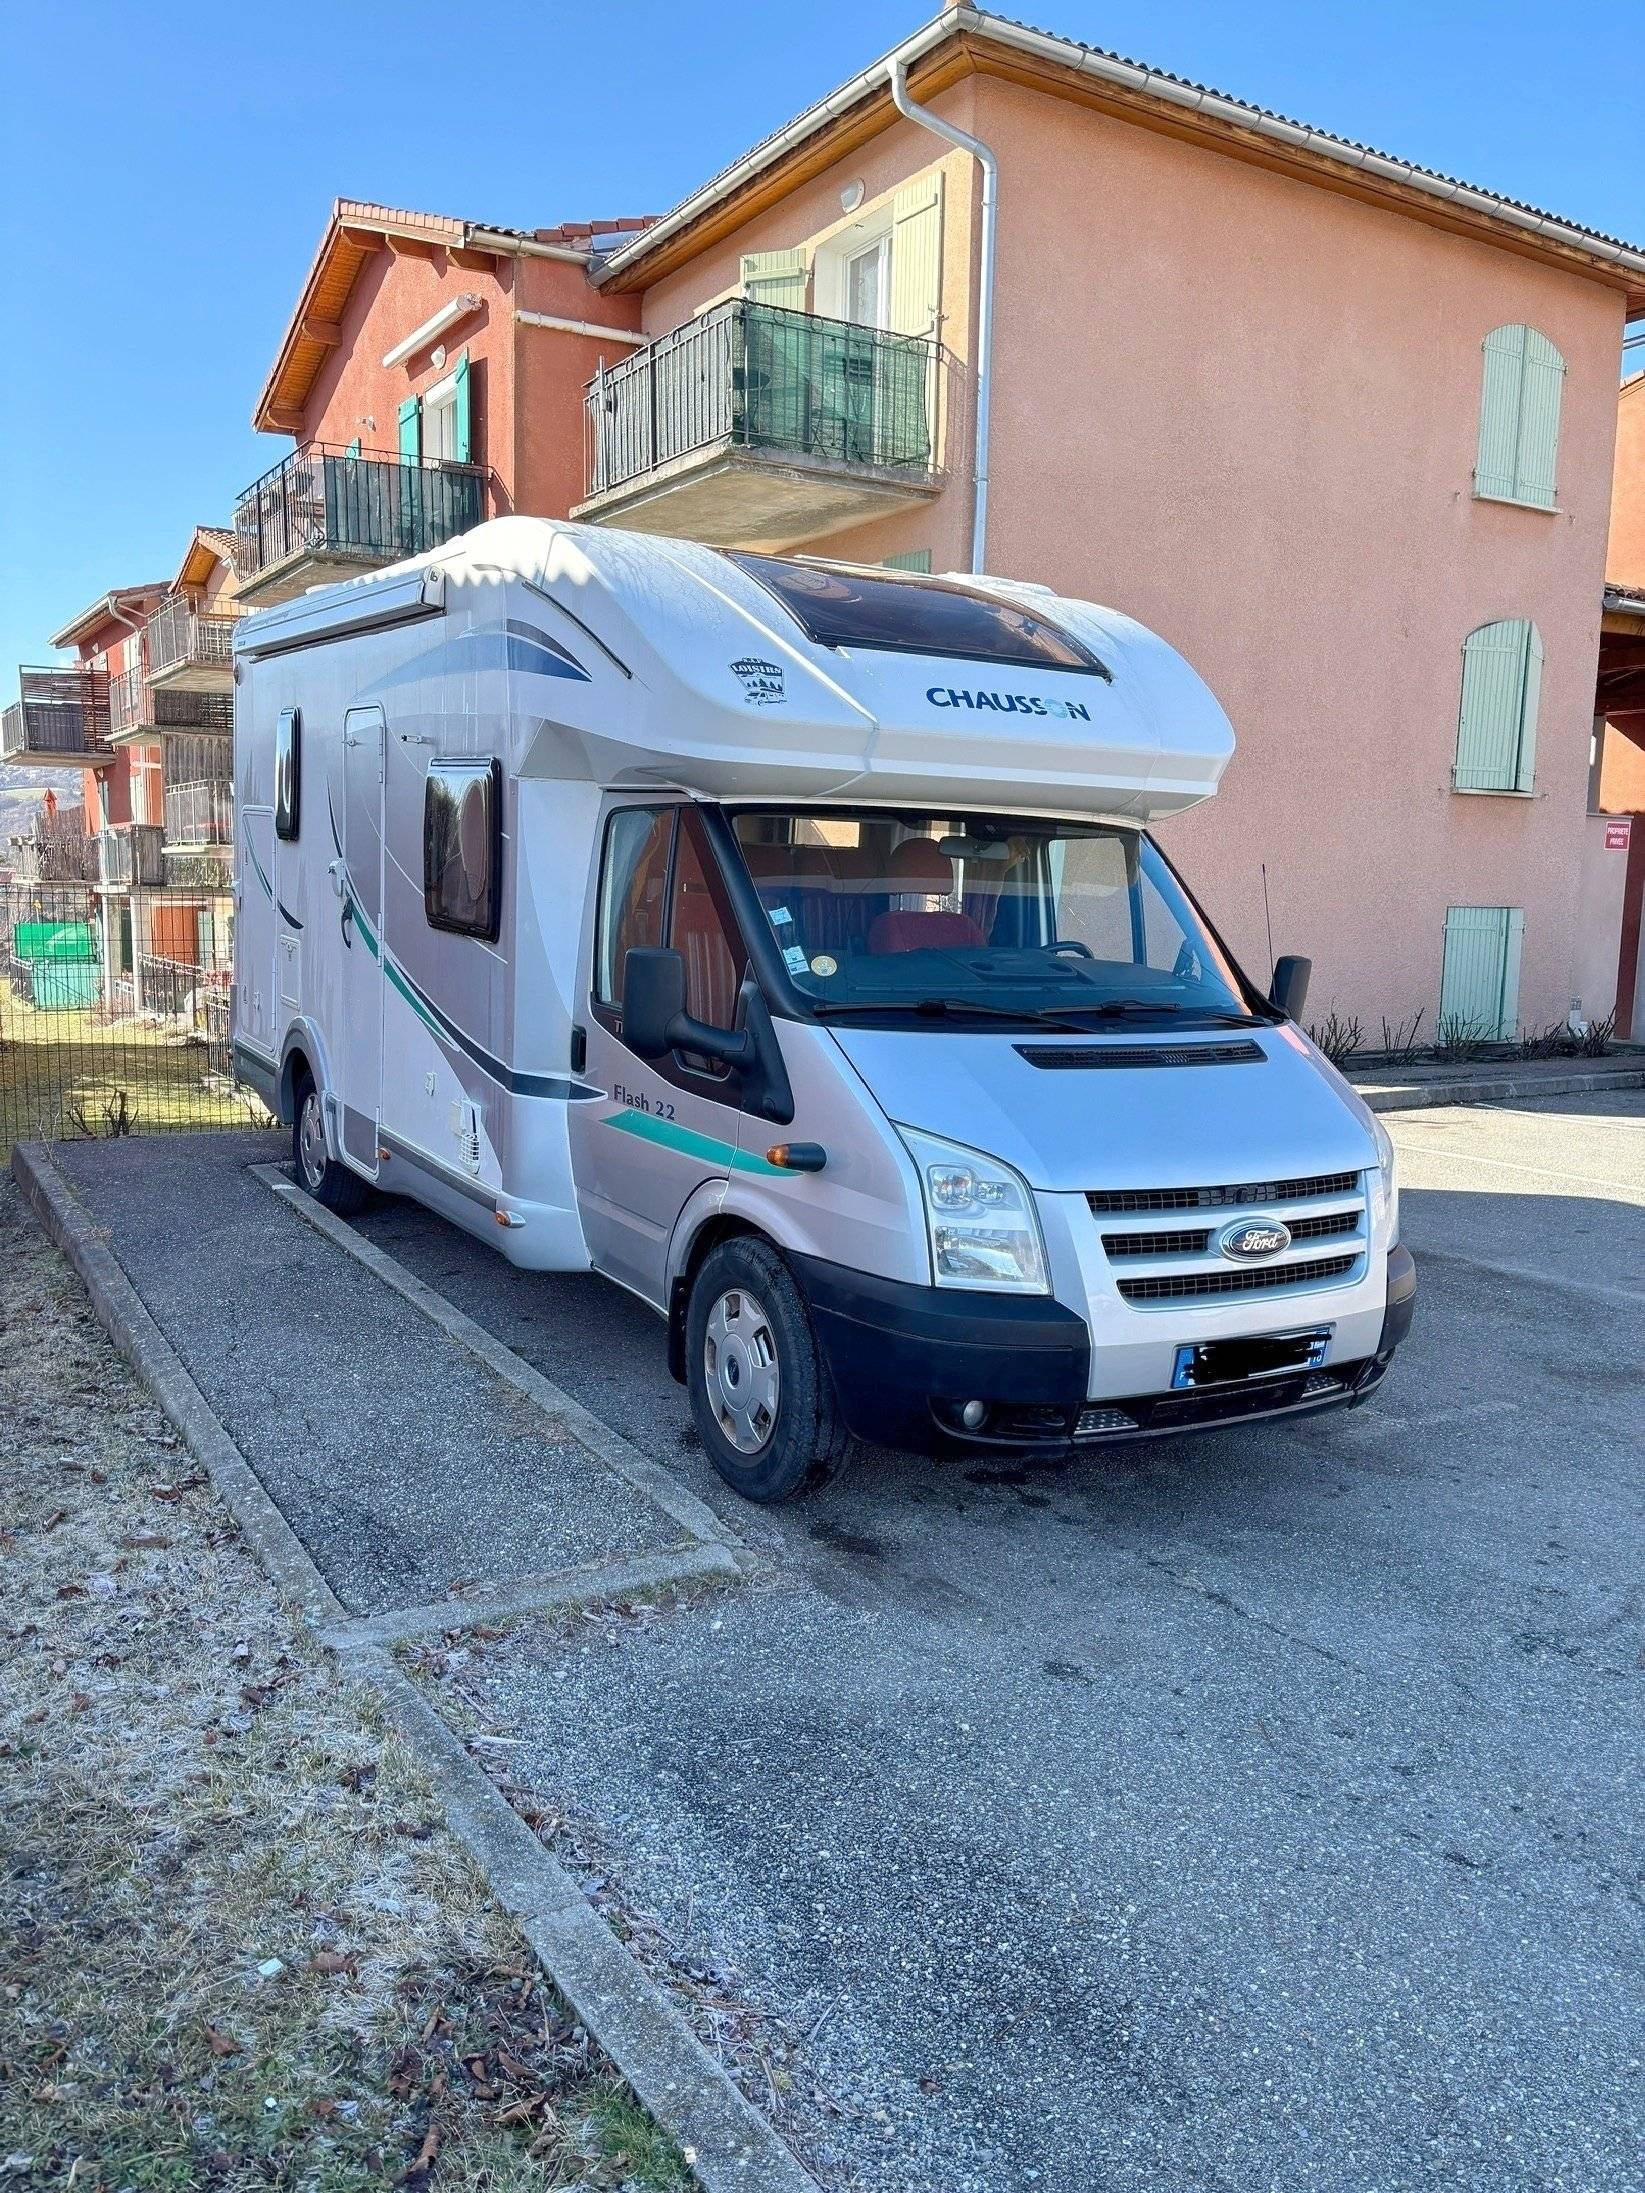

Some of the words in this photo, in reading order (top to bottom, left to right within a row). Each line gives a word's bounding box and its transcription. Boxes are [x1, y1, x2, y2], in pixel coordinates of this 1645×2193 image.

[926, 687, 1092, 721] CHAUSSON
[613, 1083, 649, 1111] Flash
[655, 1100, 675, 1120] 22
[1242, 1229, 1279, 1251] Ford
